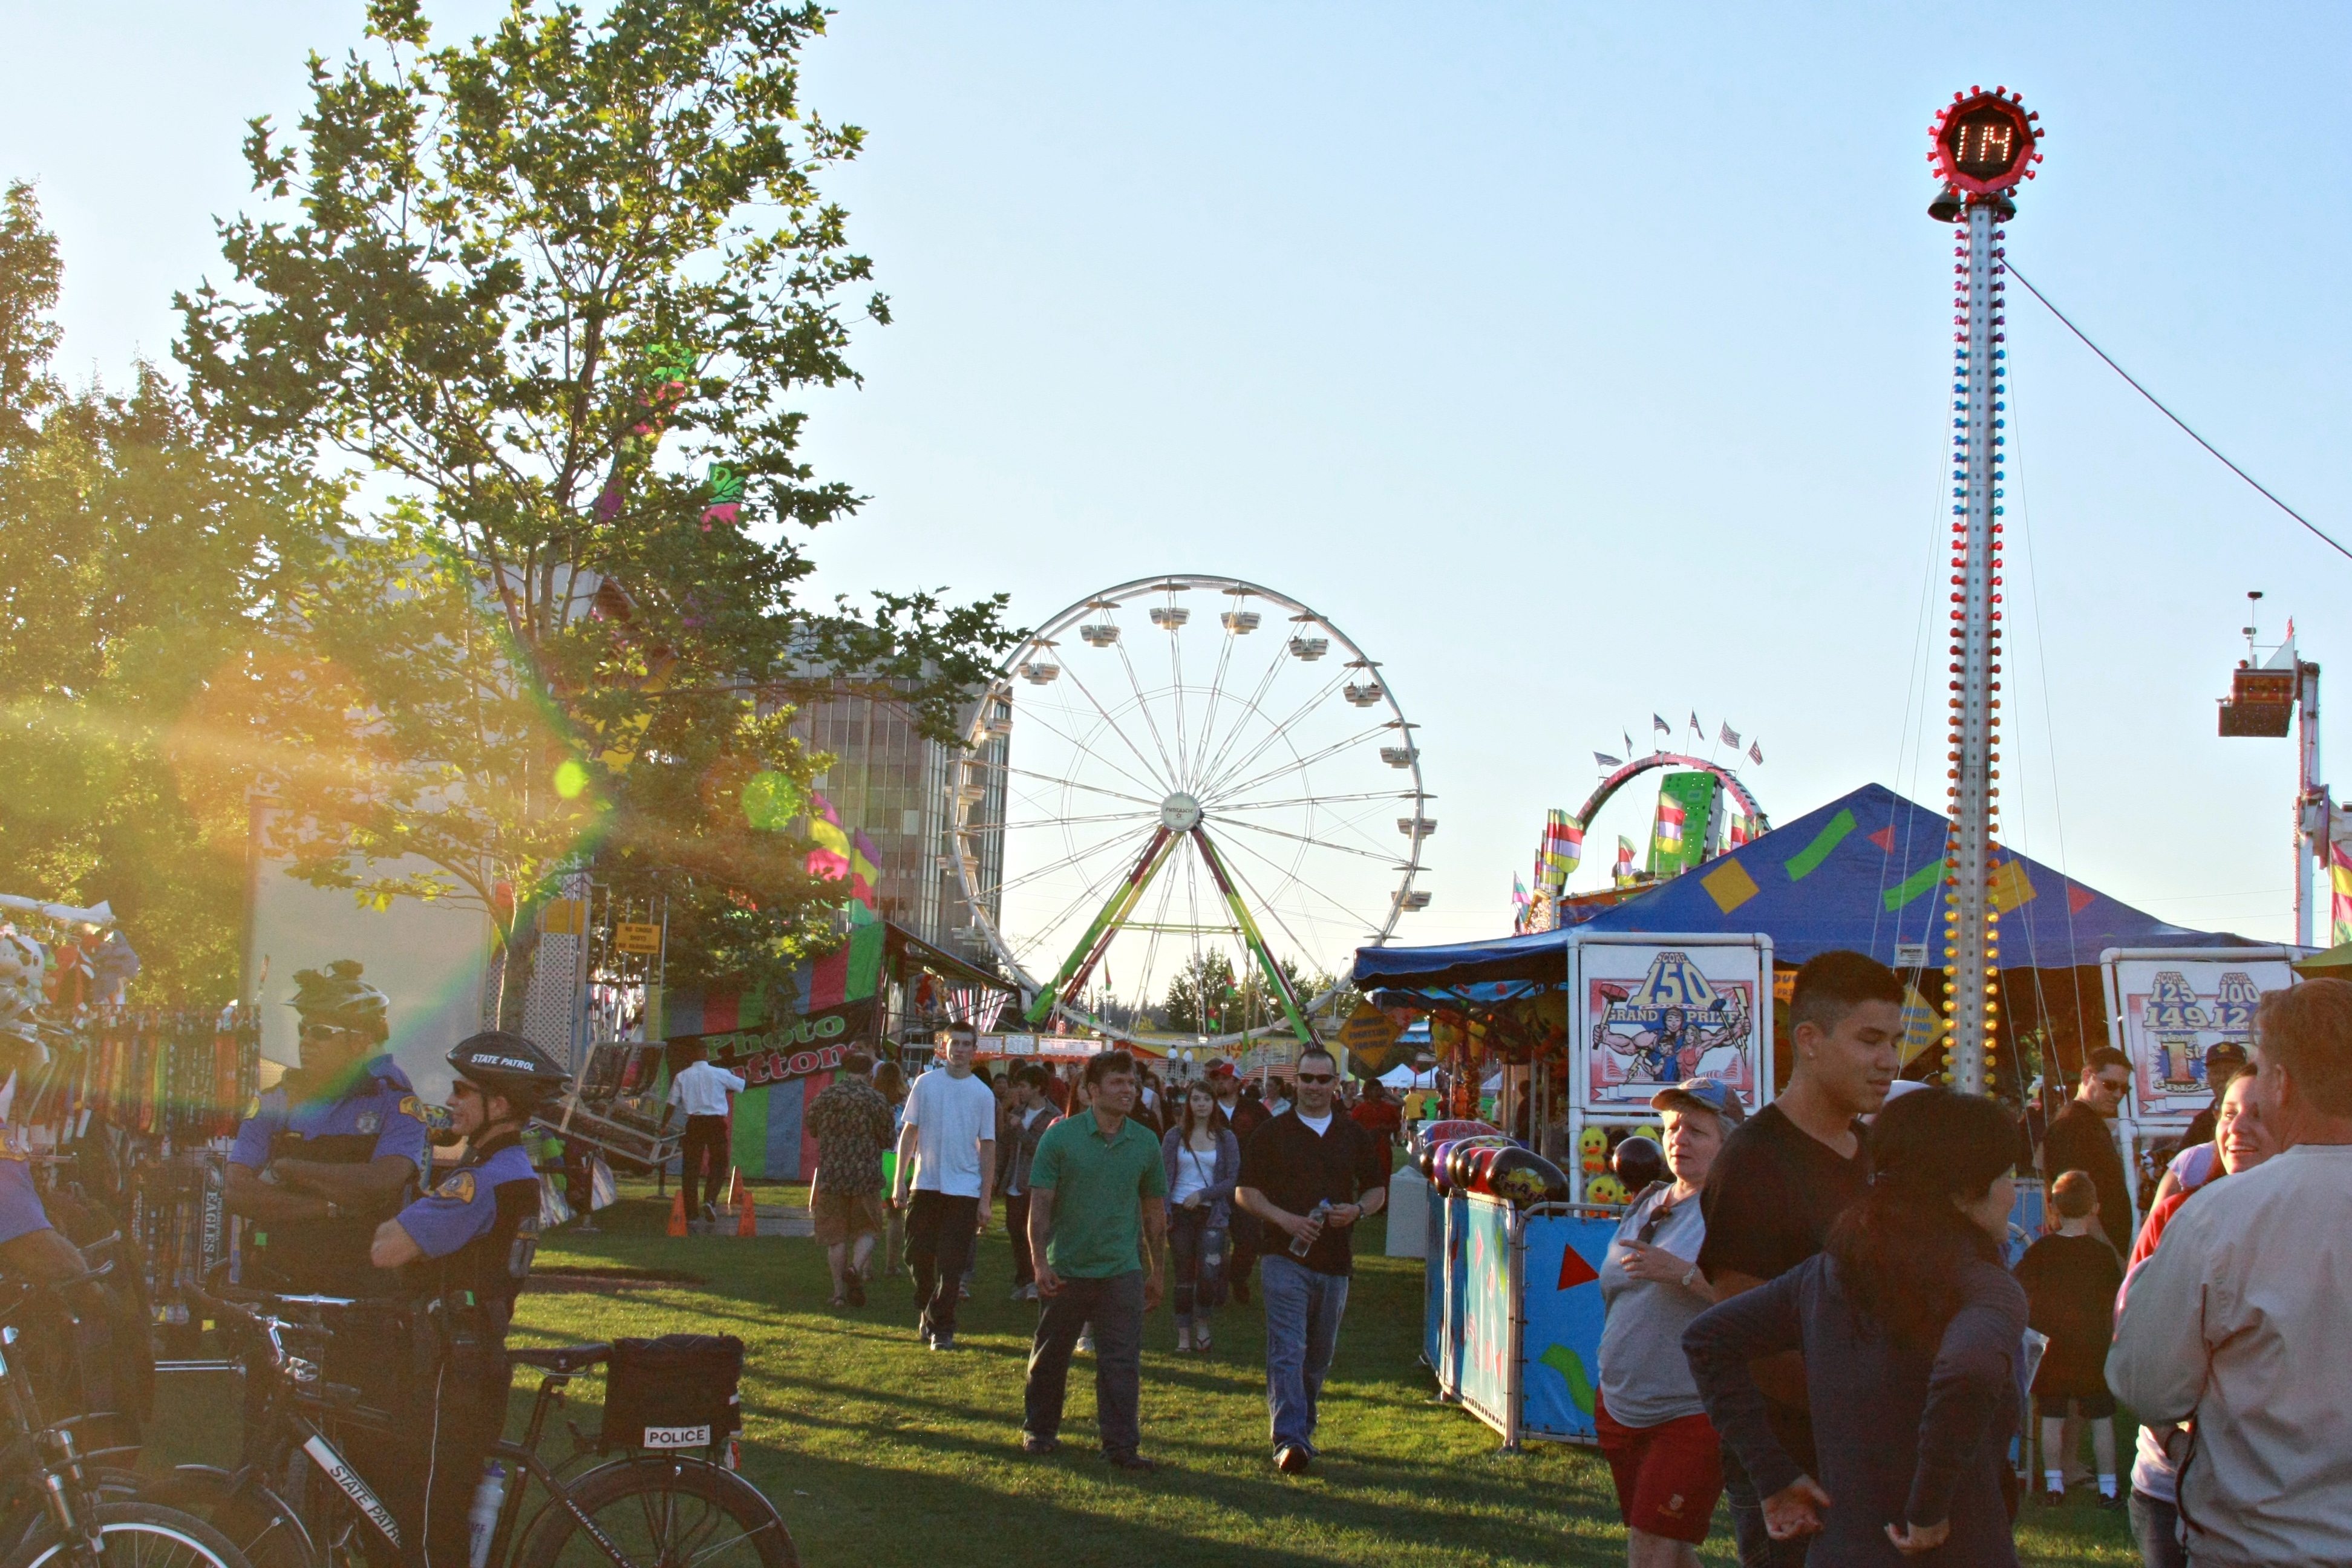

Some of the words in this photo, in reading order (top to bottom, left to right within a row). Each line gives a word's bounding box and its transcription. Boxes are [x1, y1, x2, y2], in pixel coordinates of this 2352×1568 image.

[1655, 952, 1689, 963] SCORE
[1627, 962, 1718, 1007] 150
[2155, 972, 2186, 984] SCORE
[2221, 972, 2251, 984] SCORE
[2149, 983, 2197, 1003] 125
[2216, 983, 2261, 1004] 100
[1607, 1010, 1659, 1022] GRAND
[2144, 1007, 2209, 1027] 149
[2209, 1007, 2249, 1027] 12
[701, 1015, 846, 1062] Photo
[471, 1053, 500, 1064] STATE
[500, 1058, 535, 1072] PATROL
[2161, 1042, 2201, 1085] 1st
[203, 1191, 218, 1253] EAGLES
[649, 1429, 705, 1443] POLICE
[330, 1465, 373, 1506] STATE
[368, 1505, 400, 1544] PATR
[566, 1499, 610, 1547] HANDMADE
[610, 1549, 621, 1558] IN
